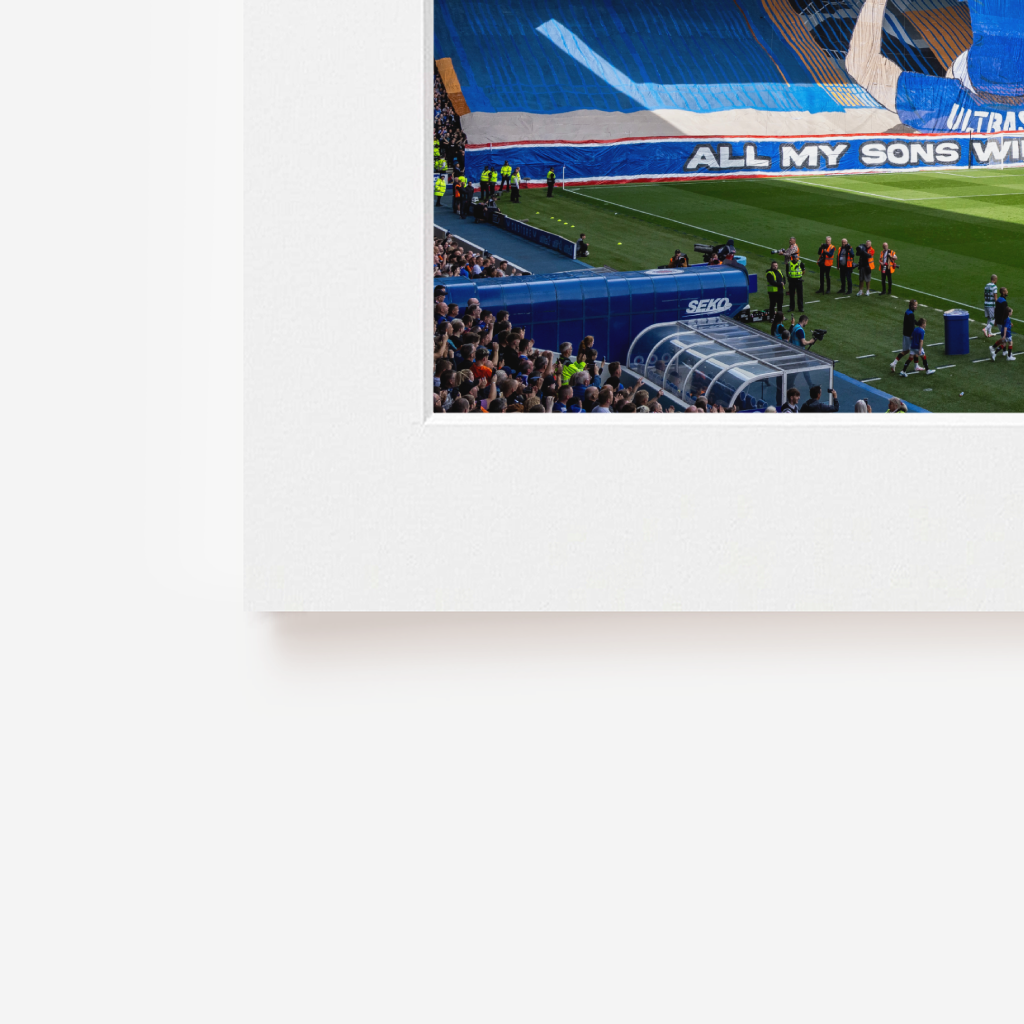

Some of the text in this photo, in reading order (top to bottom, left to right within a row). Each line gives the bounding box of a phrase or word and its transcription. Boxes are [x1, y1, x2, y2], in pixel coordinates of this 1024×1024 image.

[685, 143, 770, 170] ALL
[780, 143, 848, 169] MY
[861, 141, 962, 166] SONS
[685, 297, 733, 314] SEKO
